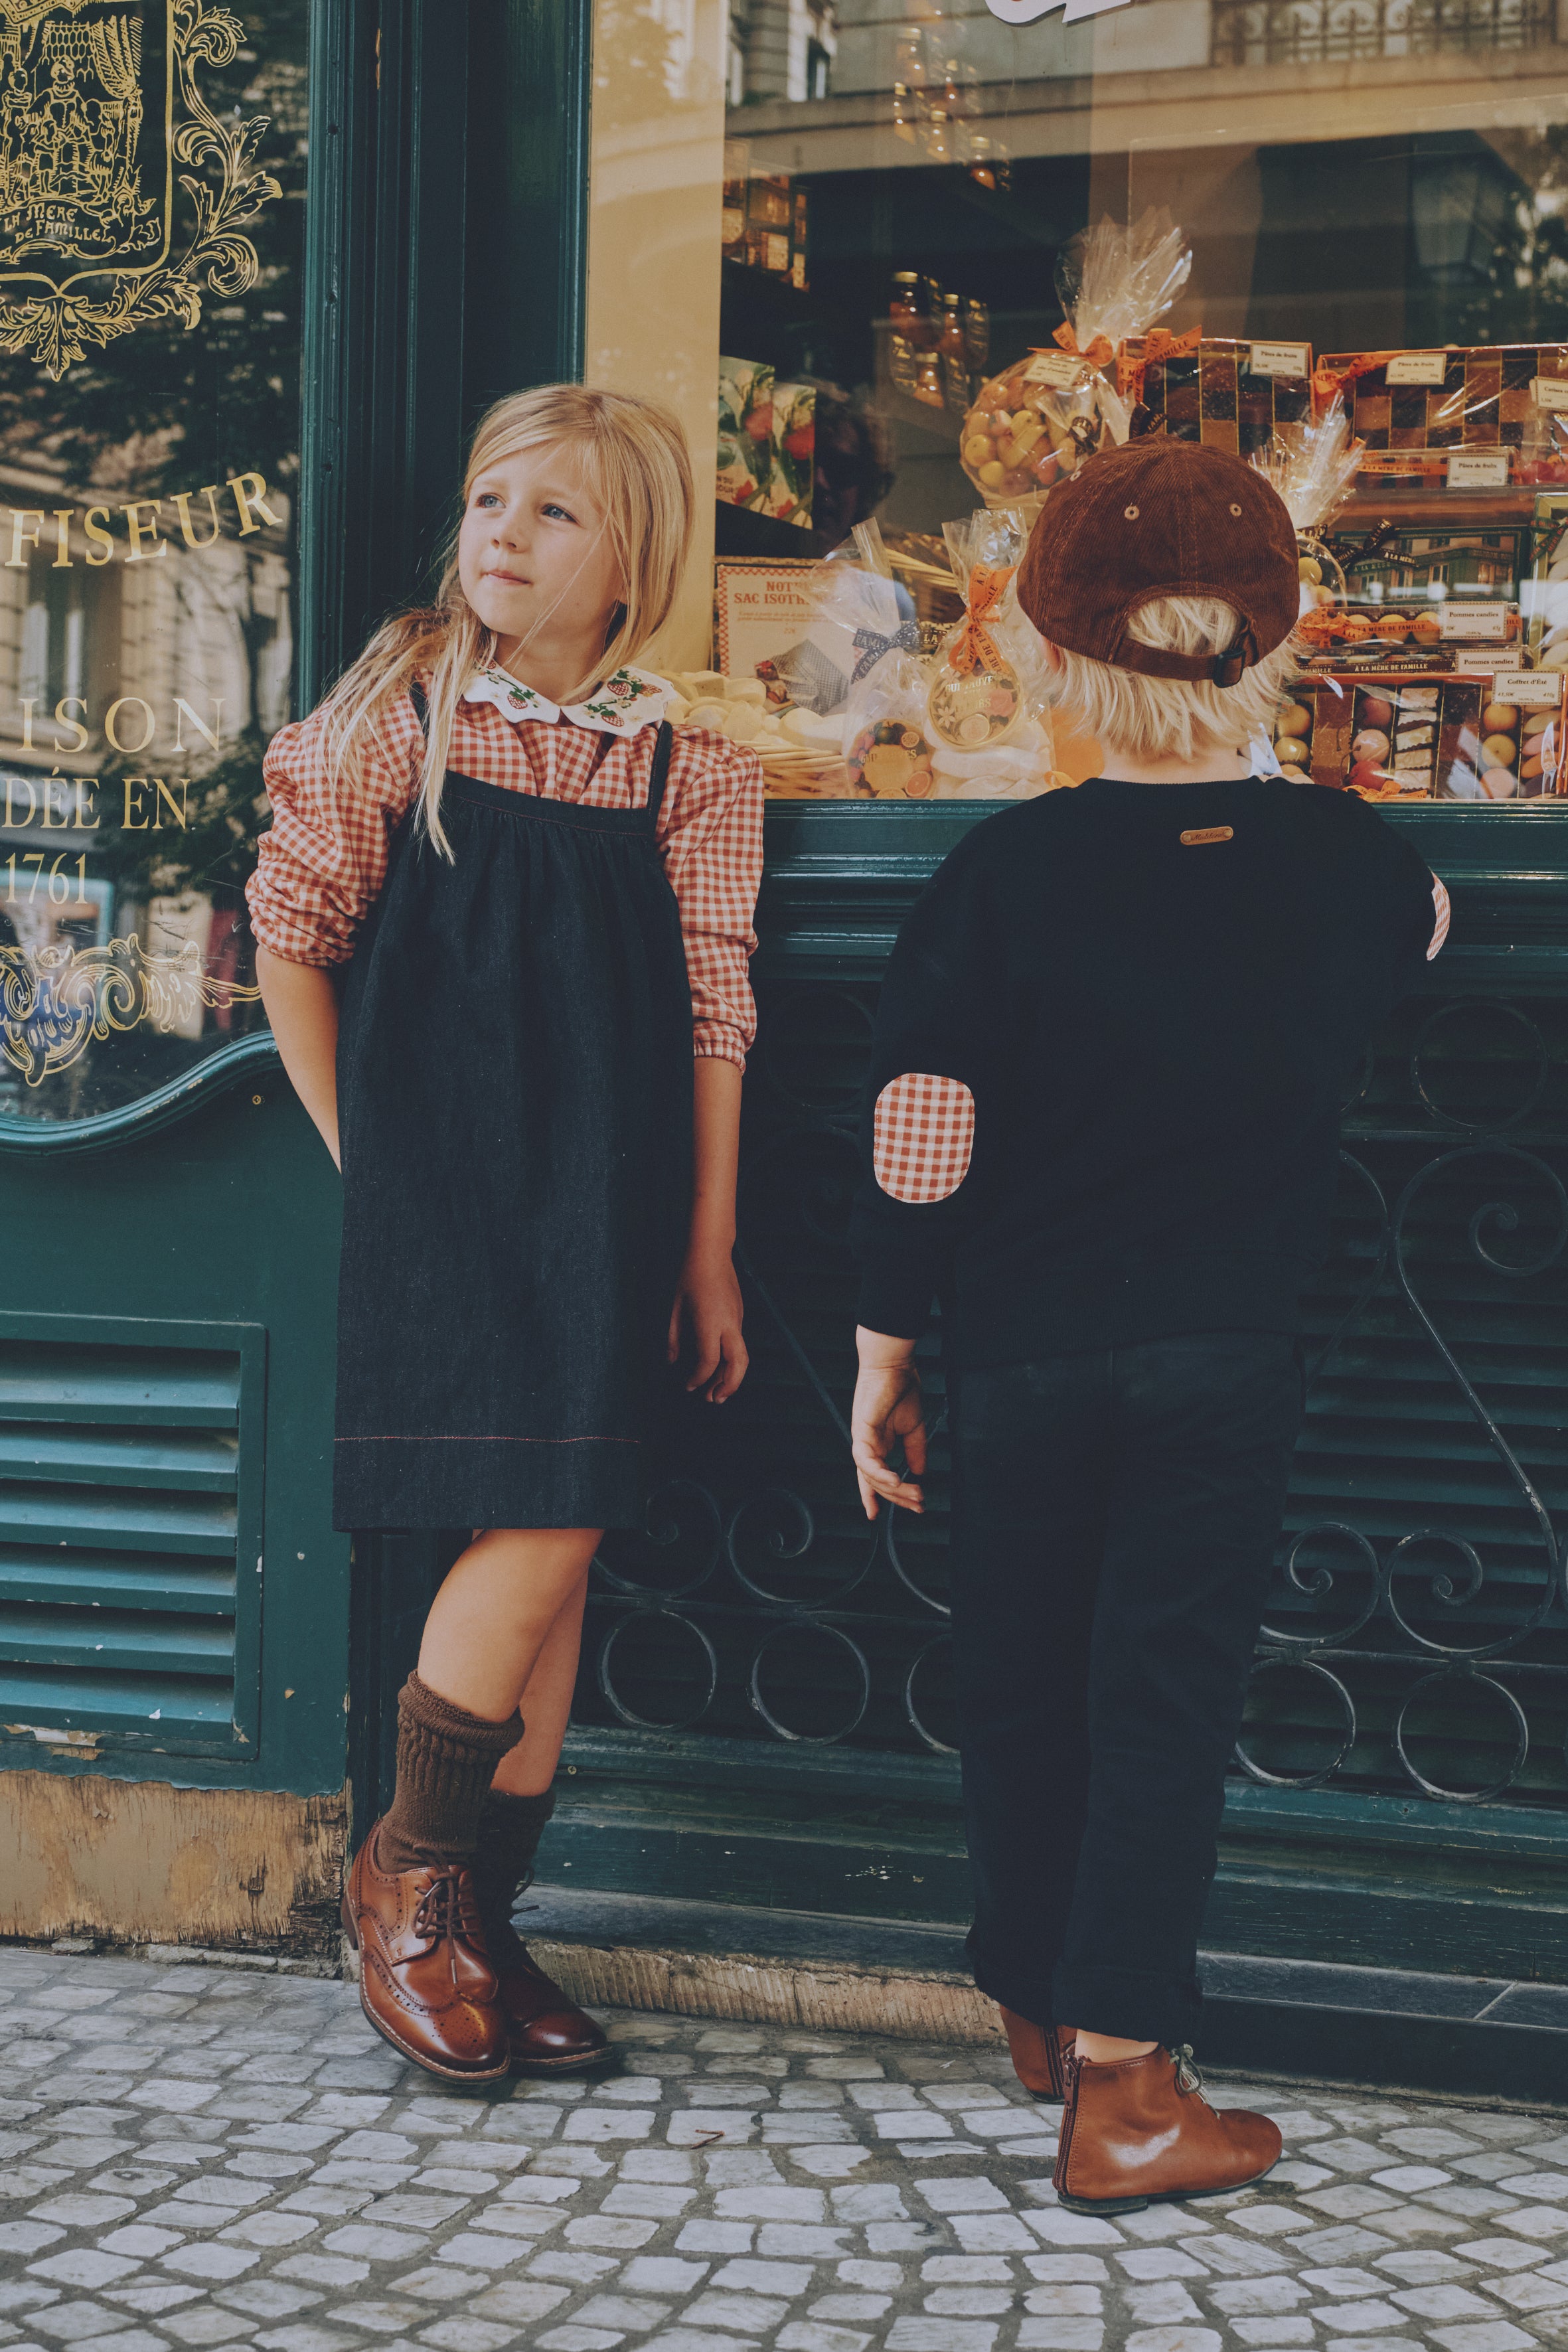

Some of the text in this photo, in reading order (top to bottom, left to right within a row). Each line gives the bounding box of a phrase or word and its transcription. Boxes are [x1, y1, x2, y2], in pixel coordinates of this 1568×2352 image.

[4, 212, 21, 232] LA
[15, 218, 101, 244] DE FAMILLE
[5, 472, 283, 567] FISEUR
[734, 593, 759, 603] SAC
[923, 633, 938, 643] LA
[982, 644, 994, 656] DE
[17, 697, 227, 753] ISON
[1, 766, 191, 830] DÉE EN
[5, 852, 88, 904] 1761
